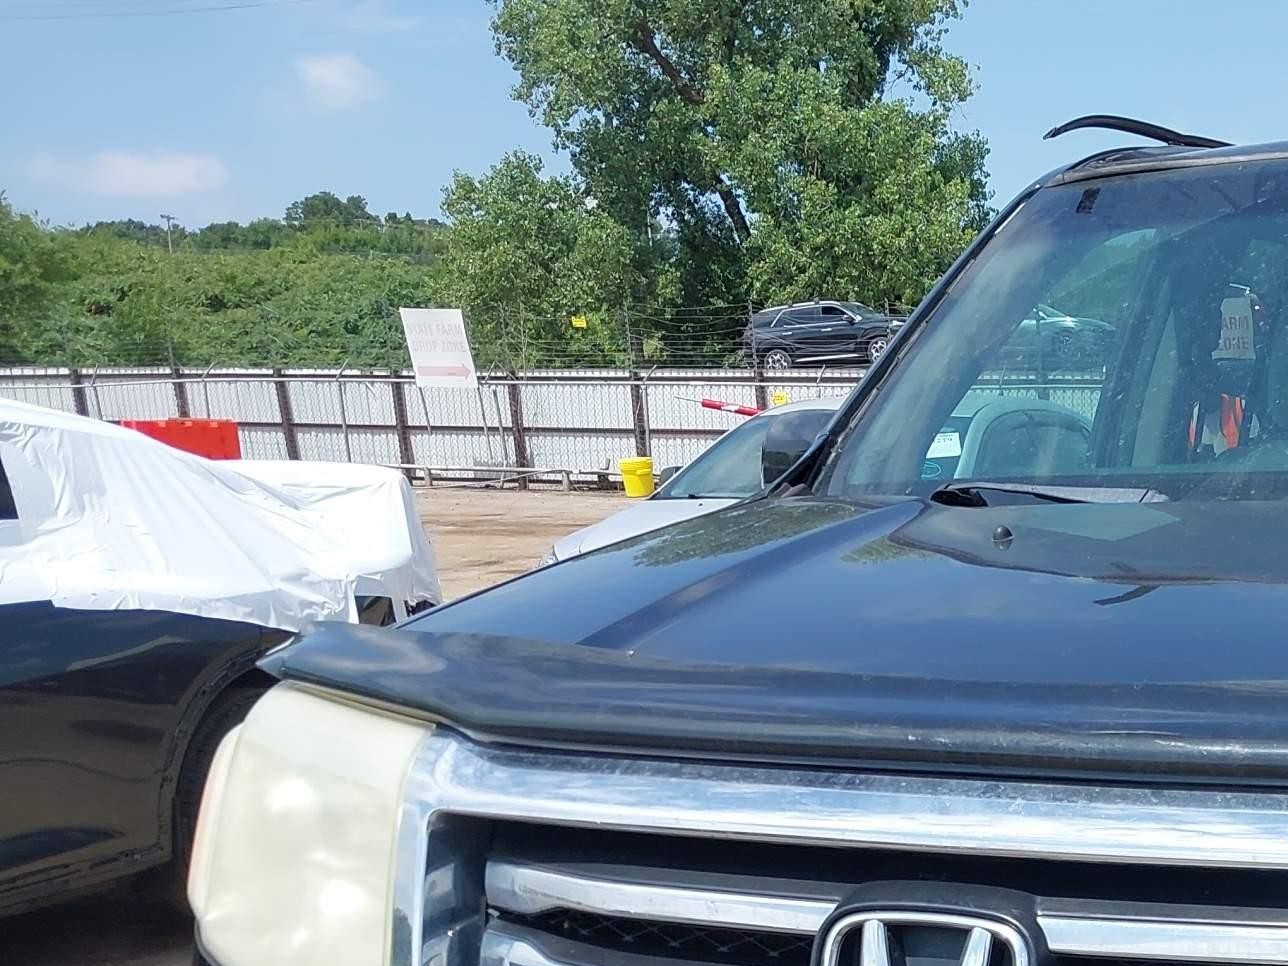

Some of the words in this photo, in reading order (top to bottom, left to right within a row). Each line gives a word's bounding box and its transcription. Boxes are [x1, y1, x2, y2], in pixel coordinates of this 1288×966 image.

[435, 323, 463, 336] FARM
[412, 340, 438, 352] DROP
[441, 340, 467, 353] ZONE
